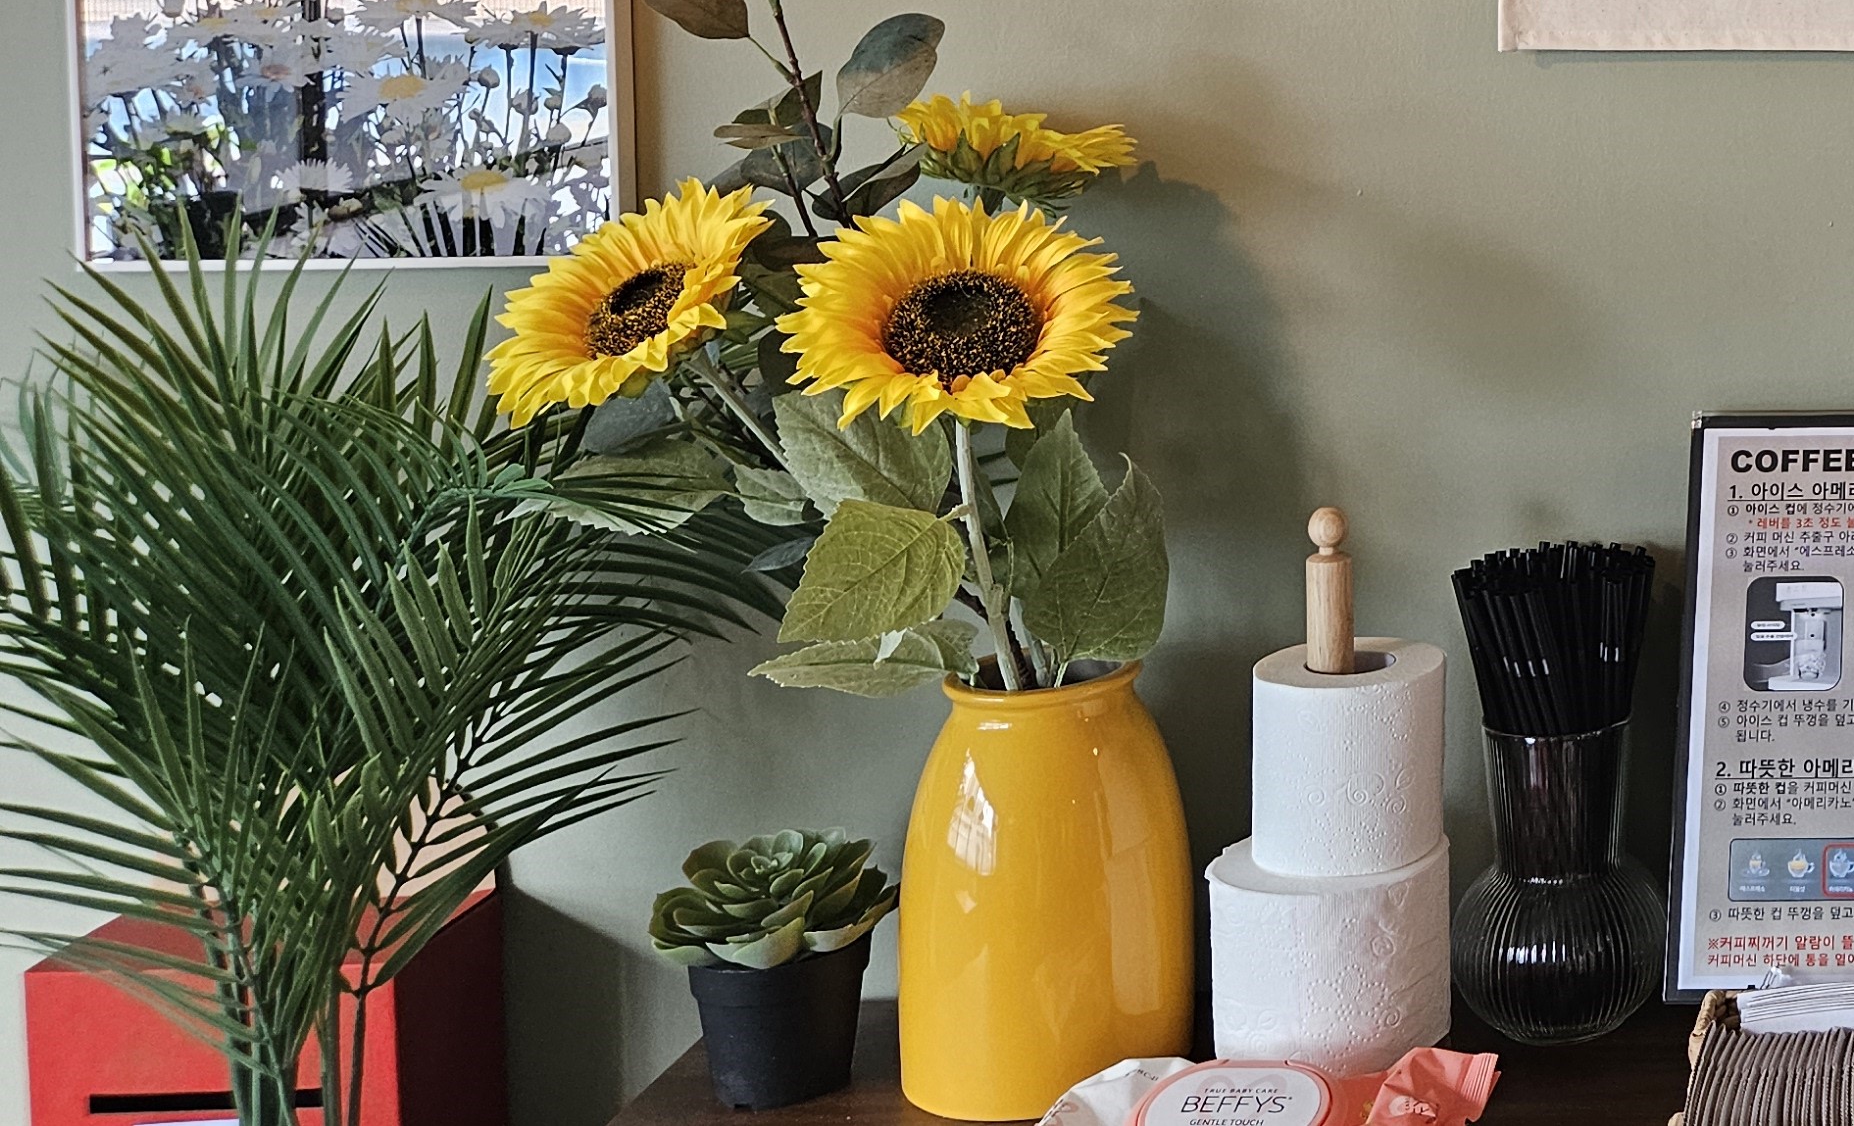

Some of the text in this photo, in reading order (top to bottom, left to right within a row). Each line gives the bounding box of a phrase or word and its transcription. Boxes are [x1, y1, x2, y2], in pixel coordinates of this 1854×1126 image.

[1730, 484, 1742, 499] 1.
[1752, 481, 1803, 499] 아이스
[1746, 503, 1780, 517] 아이스
[1785, 503, 1807, 516] 컵에
[1757, 516, 1790, 530] 레버를
[1796, 517, 1813, 529] 3초
[1819, 516, 1841, 530] 정도
[1744, 532, 1767, 544] 커피
[1772, 531, 1795, 544] 머신
[1799, 530, 1834, 543] 추출구
[1743, 545, 1790, 559] 화면에서
[1743, 559, 1804, 573] 눌러주세요.
[1737, 698, 1796, 713] 정수기에서
[1803, 698, 1837, 713] 냉수를
[1737, 714, 1772, 728] 아이스
[1778, 714, 1788, 728] 컵
[1736, 729, 1774, 743] 됩니다.
[1716, 761, 1731, 780] 2.
[1740, 758, 1795, 780] 따뜻한
[1733, 781, 1770, 796] 따뜻한
[1775, 781, 1799, 796] 컵을
[1804, 780, 1851, 795] 커피머신
[1733, 796, 1781, 811] 화면에서
[1733, 811, 1796, 827] 눌러주세요.
[1728, 906, 1764, 921] 따뜻한
[1771, 906, 1782, 921] 컵
[1795, 934, 1834, 951] 알람이
[1708, 953, 1756, 968] 커피머신
[1763, 953, 1799, 968] 하단에
[1806, 953, 1828, 967] 통을
[1181, 1095, 1287, 1113] BEFFYS
